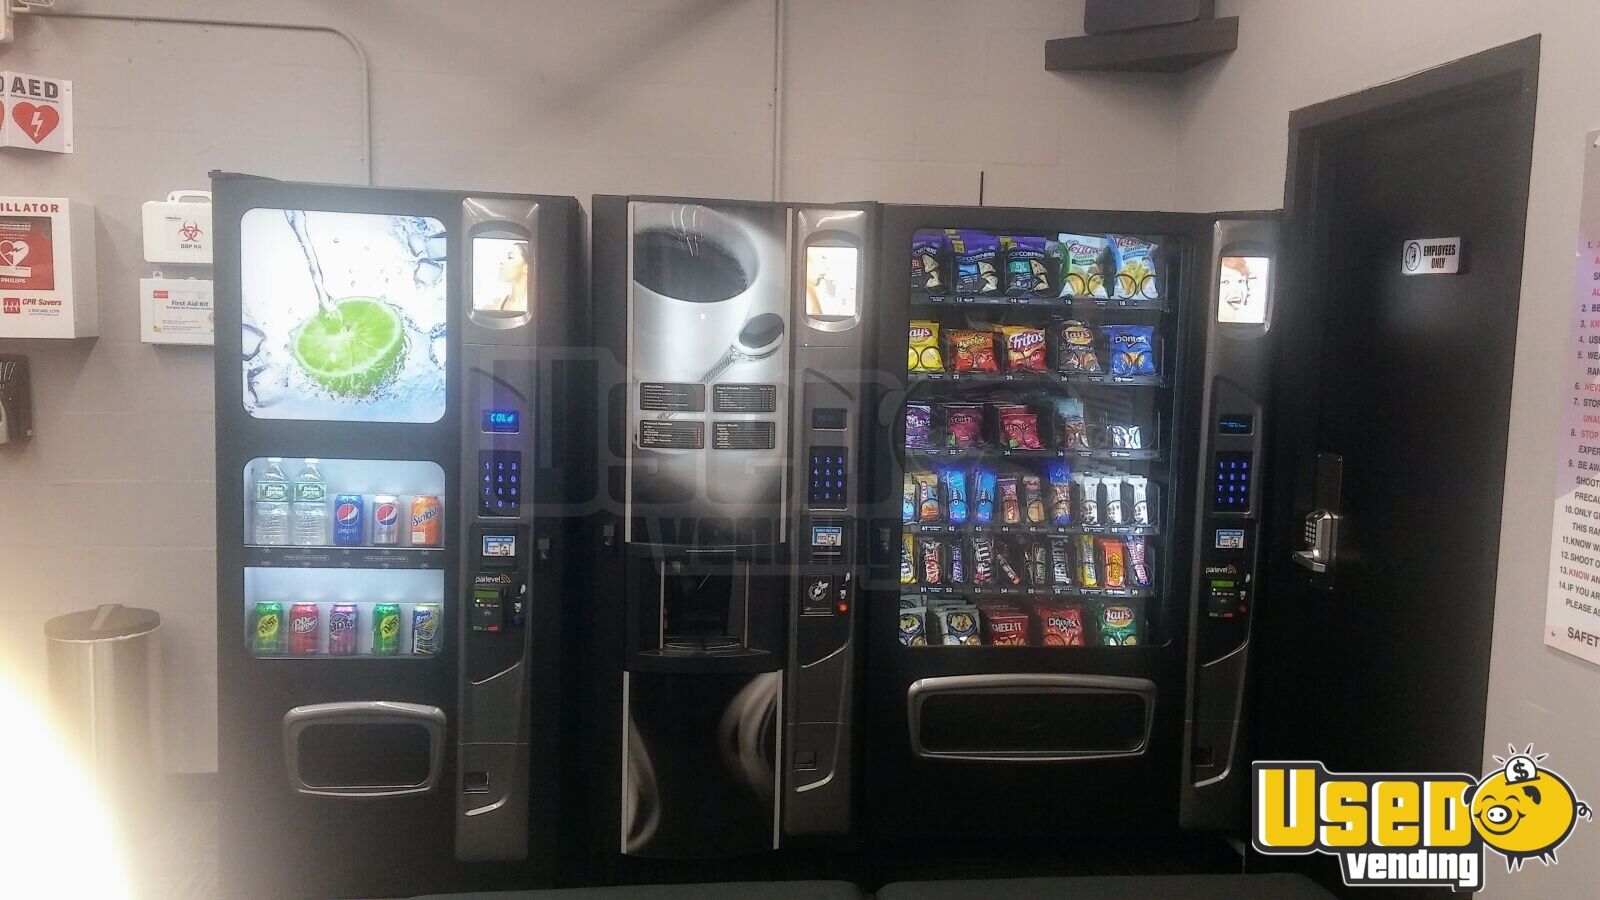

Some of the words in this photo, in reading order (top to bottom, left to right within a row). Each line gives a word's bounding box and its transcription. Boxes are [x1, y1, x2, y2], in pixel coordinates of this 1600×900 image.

[11, 76, 59, 98] AED
[0, 203, 59, 213] ILLATOR
[1423, 245, 1456, 256] EMPLOYEES
[1431, 257, 1445, 269] ONLY
[22, 298, 36, 306] CPR
[38, 298, 62, 306] Savers
[1009, 332, 1045, 350] Fritos
[1115, 334, 1148, 344] Doritos
[1570, 428, 1577, 437] 8.
[1580, 430, 1600, 440] STOP
[1568, 459, 1574, 468] 9.
[1578, 460, 1588, 470] BE
[1572, 522, 1588, 533] THIS
[475, 576, 501, 584] parlevel
[1575, 585, 1589, 597] YOU
[1566, 598, 1592, 615] PLEASE
[991, 622, 1022, 632] CHEEZ-IT
